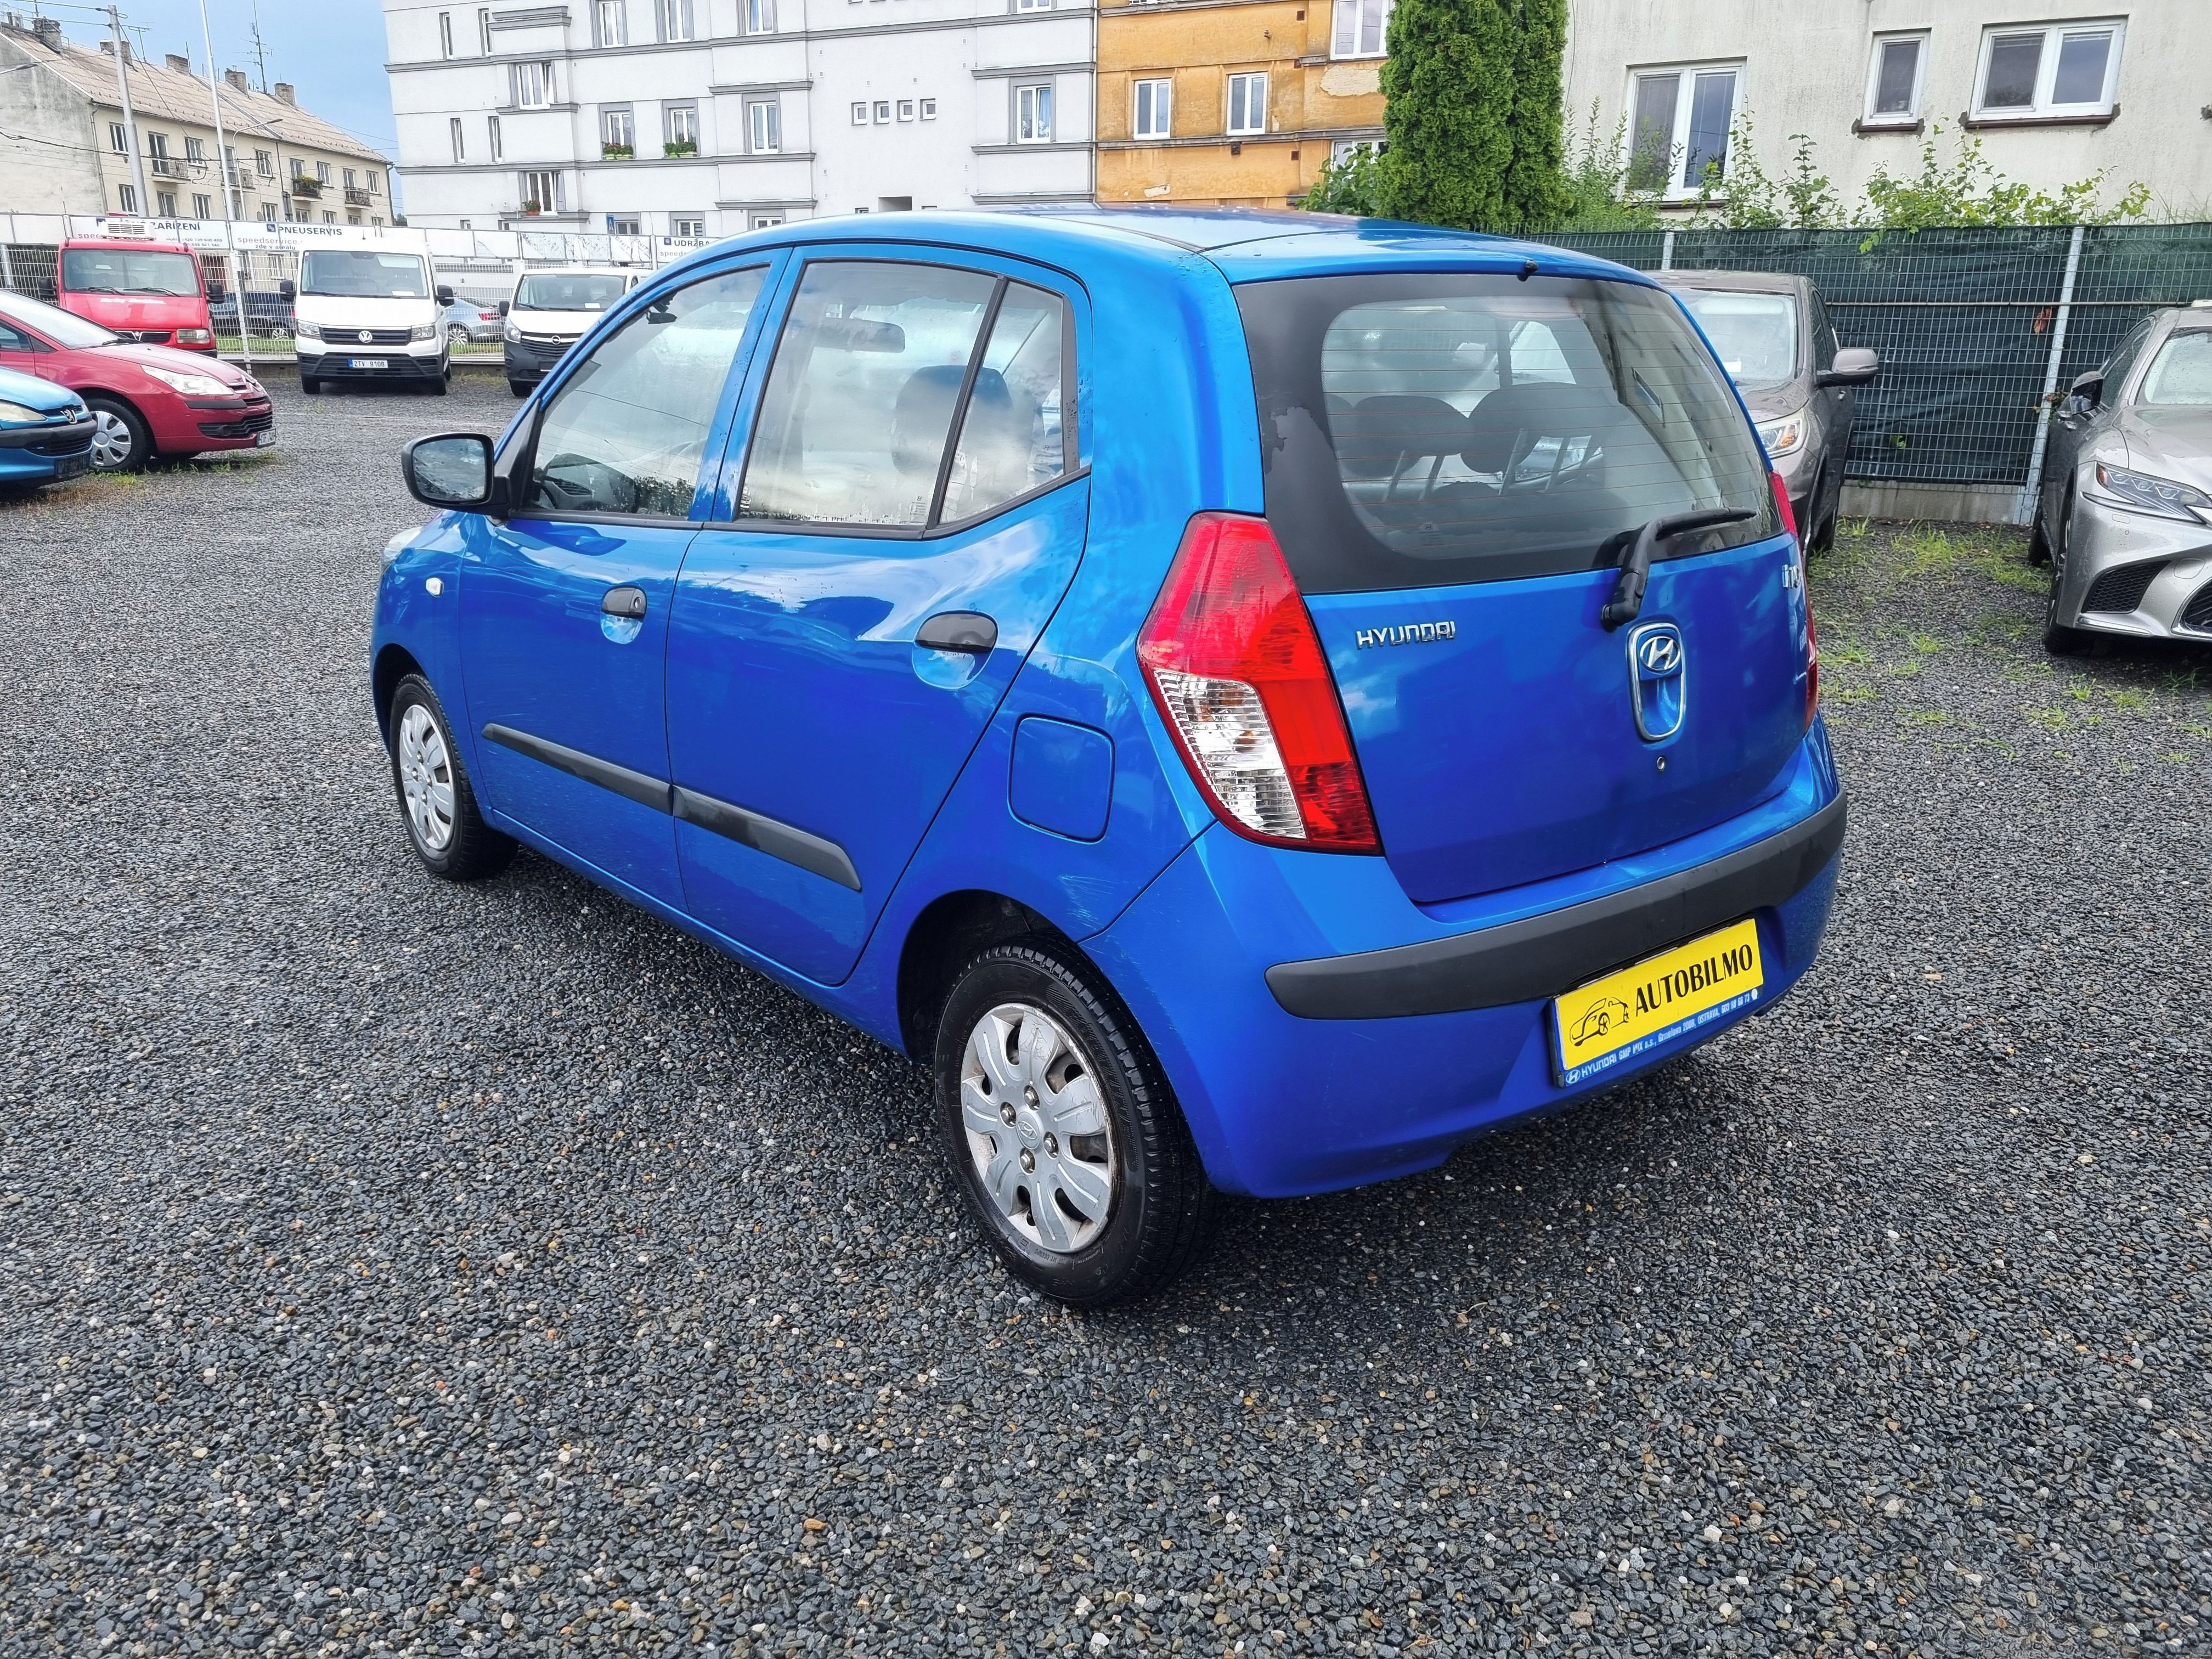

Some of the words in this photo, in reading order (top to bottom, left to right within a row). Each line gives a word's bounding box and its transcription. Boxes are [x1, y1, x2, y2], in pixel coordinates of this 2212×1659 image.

[279, 226, 342, 235] PNEUSERVIS
[1356, 621, 1455, 650] HYUNDAI
[1636, 944, 1753, 1017] AUTOBILMO
[1582, 1053, 1617, 1077] HYUNDAI
[1619, 1047, 1631, 1060] GMP
[1633, 1041, 1643, 1054] MIX
